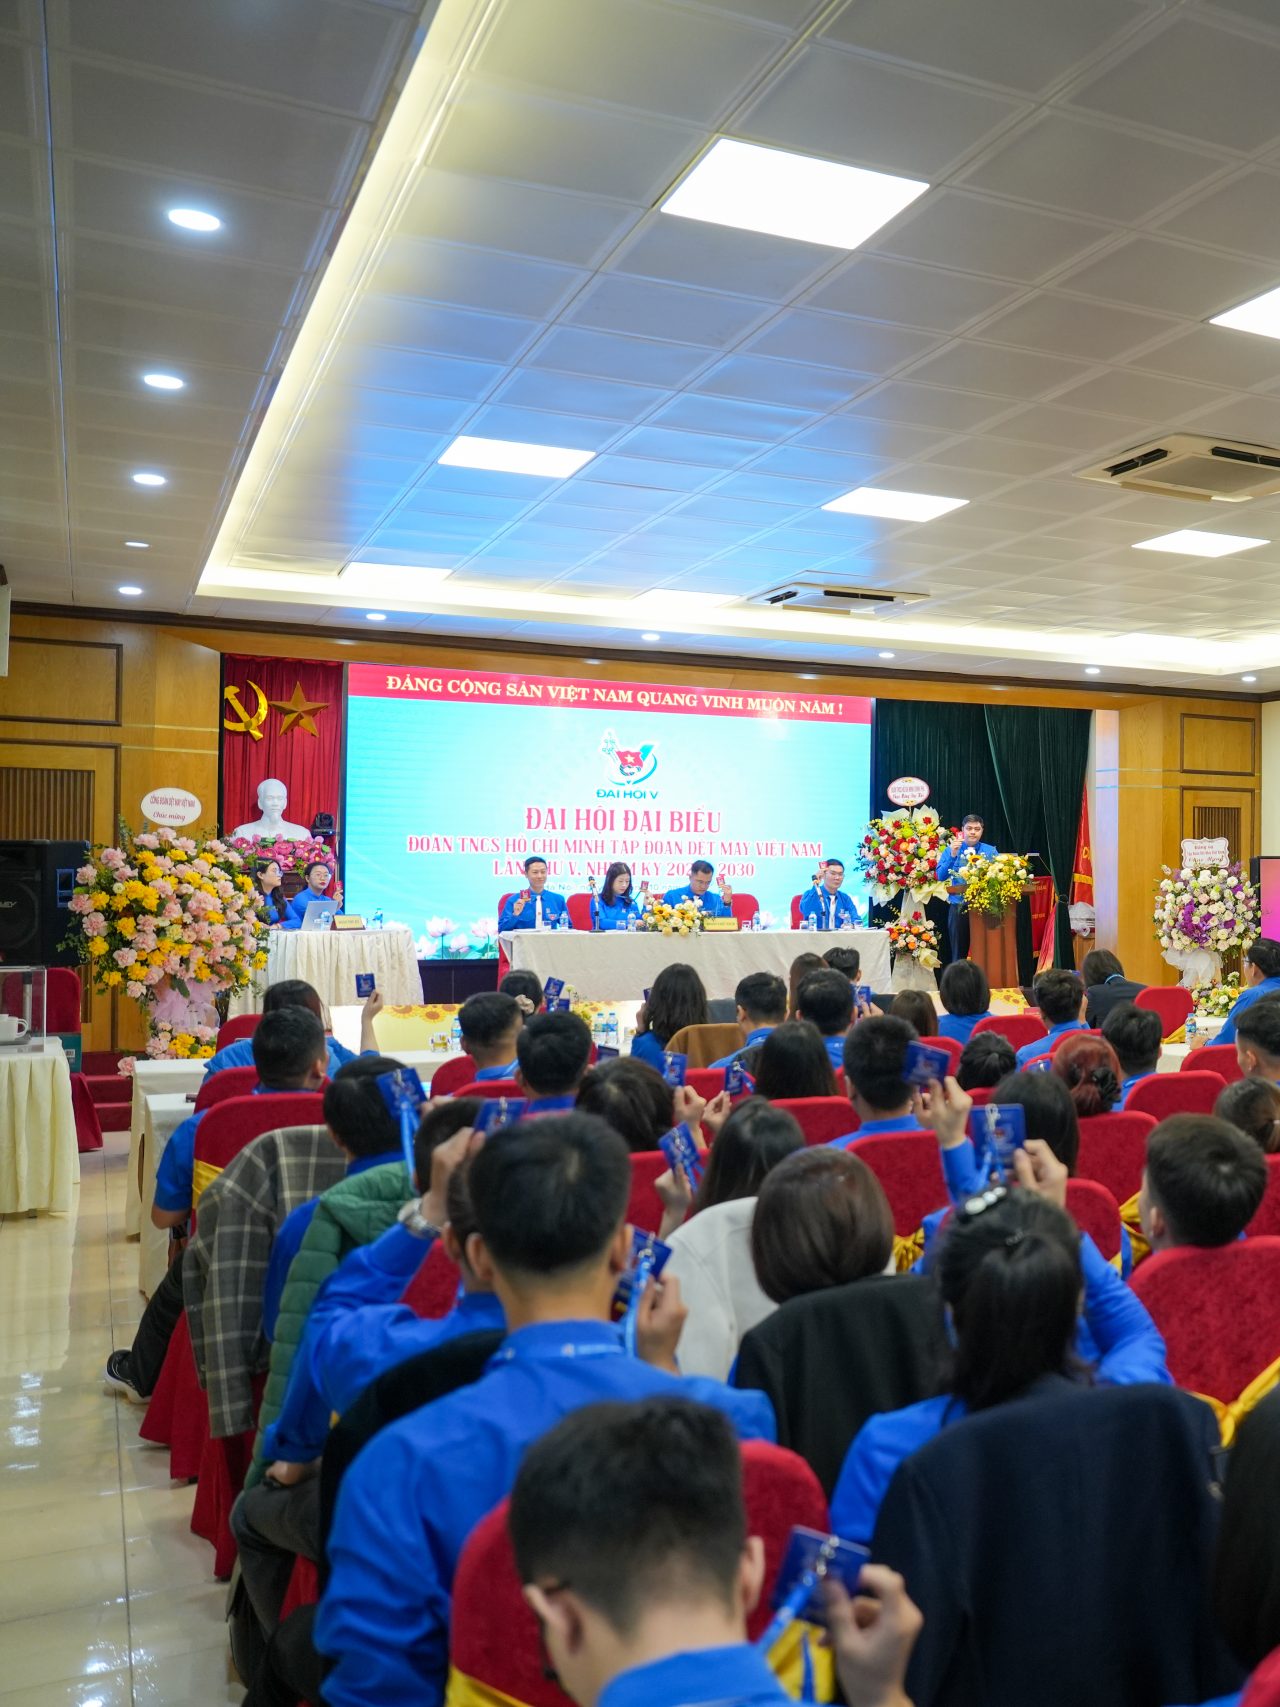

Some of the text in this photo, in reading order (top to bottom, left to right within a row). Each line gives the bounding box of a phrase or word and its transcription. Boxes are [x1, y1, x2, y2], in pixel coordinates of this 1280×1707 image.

[386, 674, 843, 715] ĐẢNG CỘNG SẢN VIỆT NAM QUANG VINH MUÔN NĂM !
[649, 790, 659, 800] V
[526, 805, 721, 835] ĐẠI HỘI ĐẠI BIỂU
[458, 837, 500, 852] TNCS
[564, 839, 605, 854] MINH
[720, 841, 750, 856] MAY
[791, 842, 822, 857] NAM
[667, 862, 692, 877] 202
[718, 862, 755, 877] 2030
